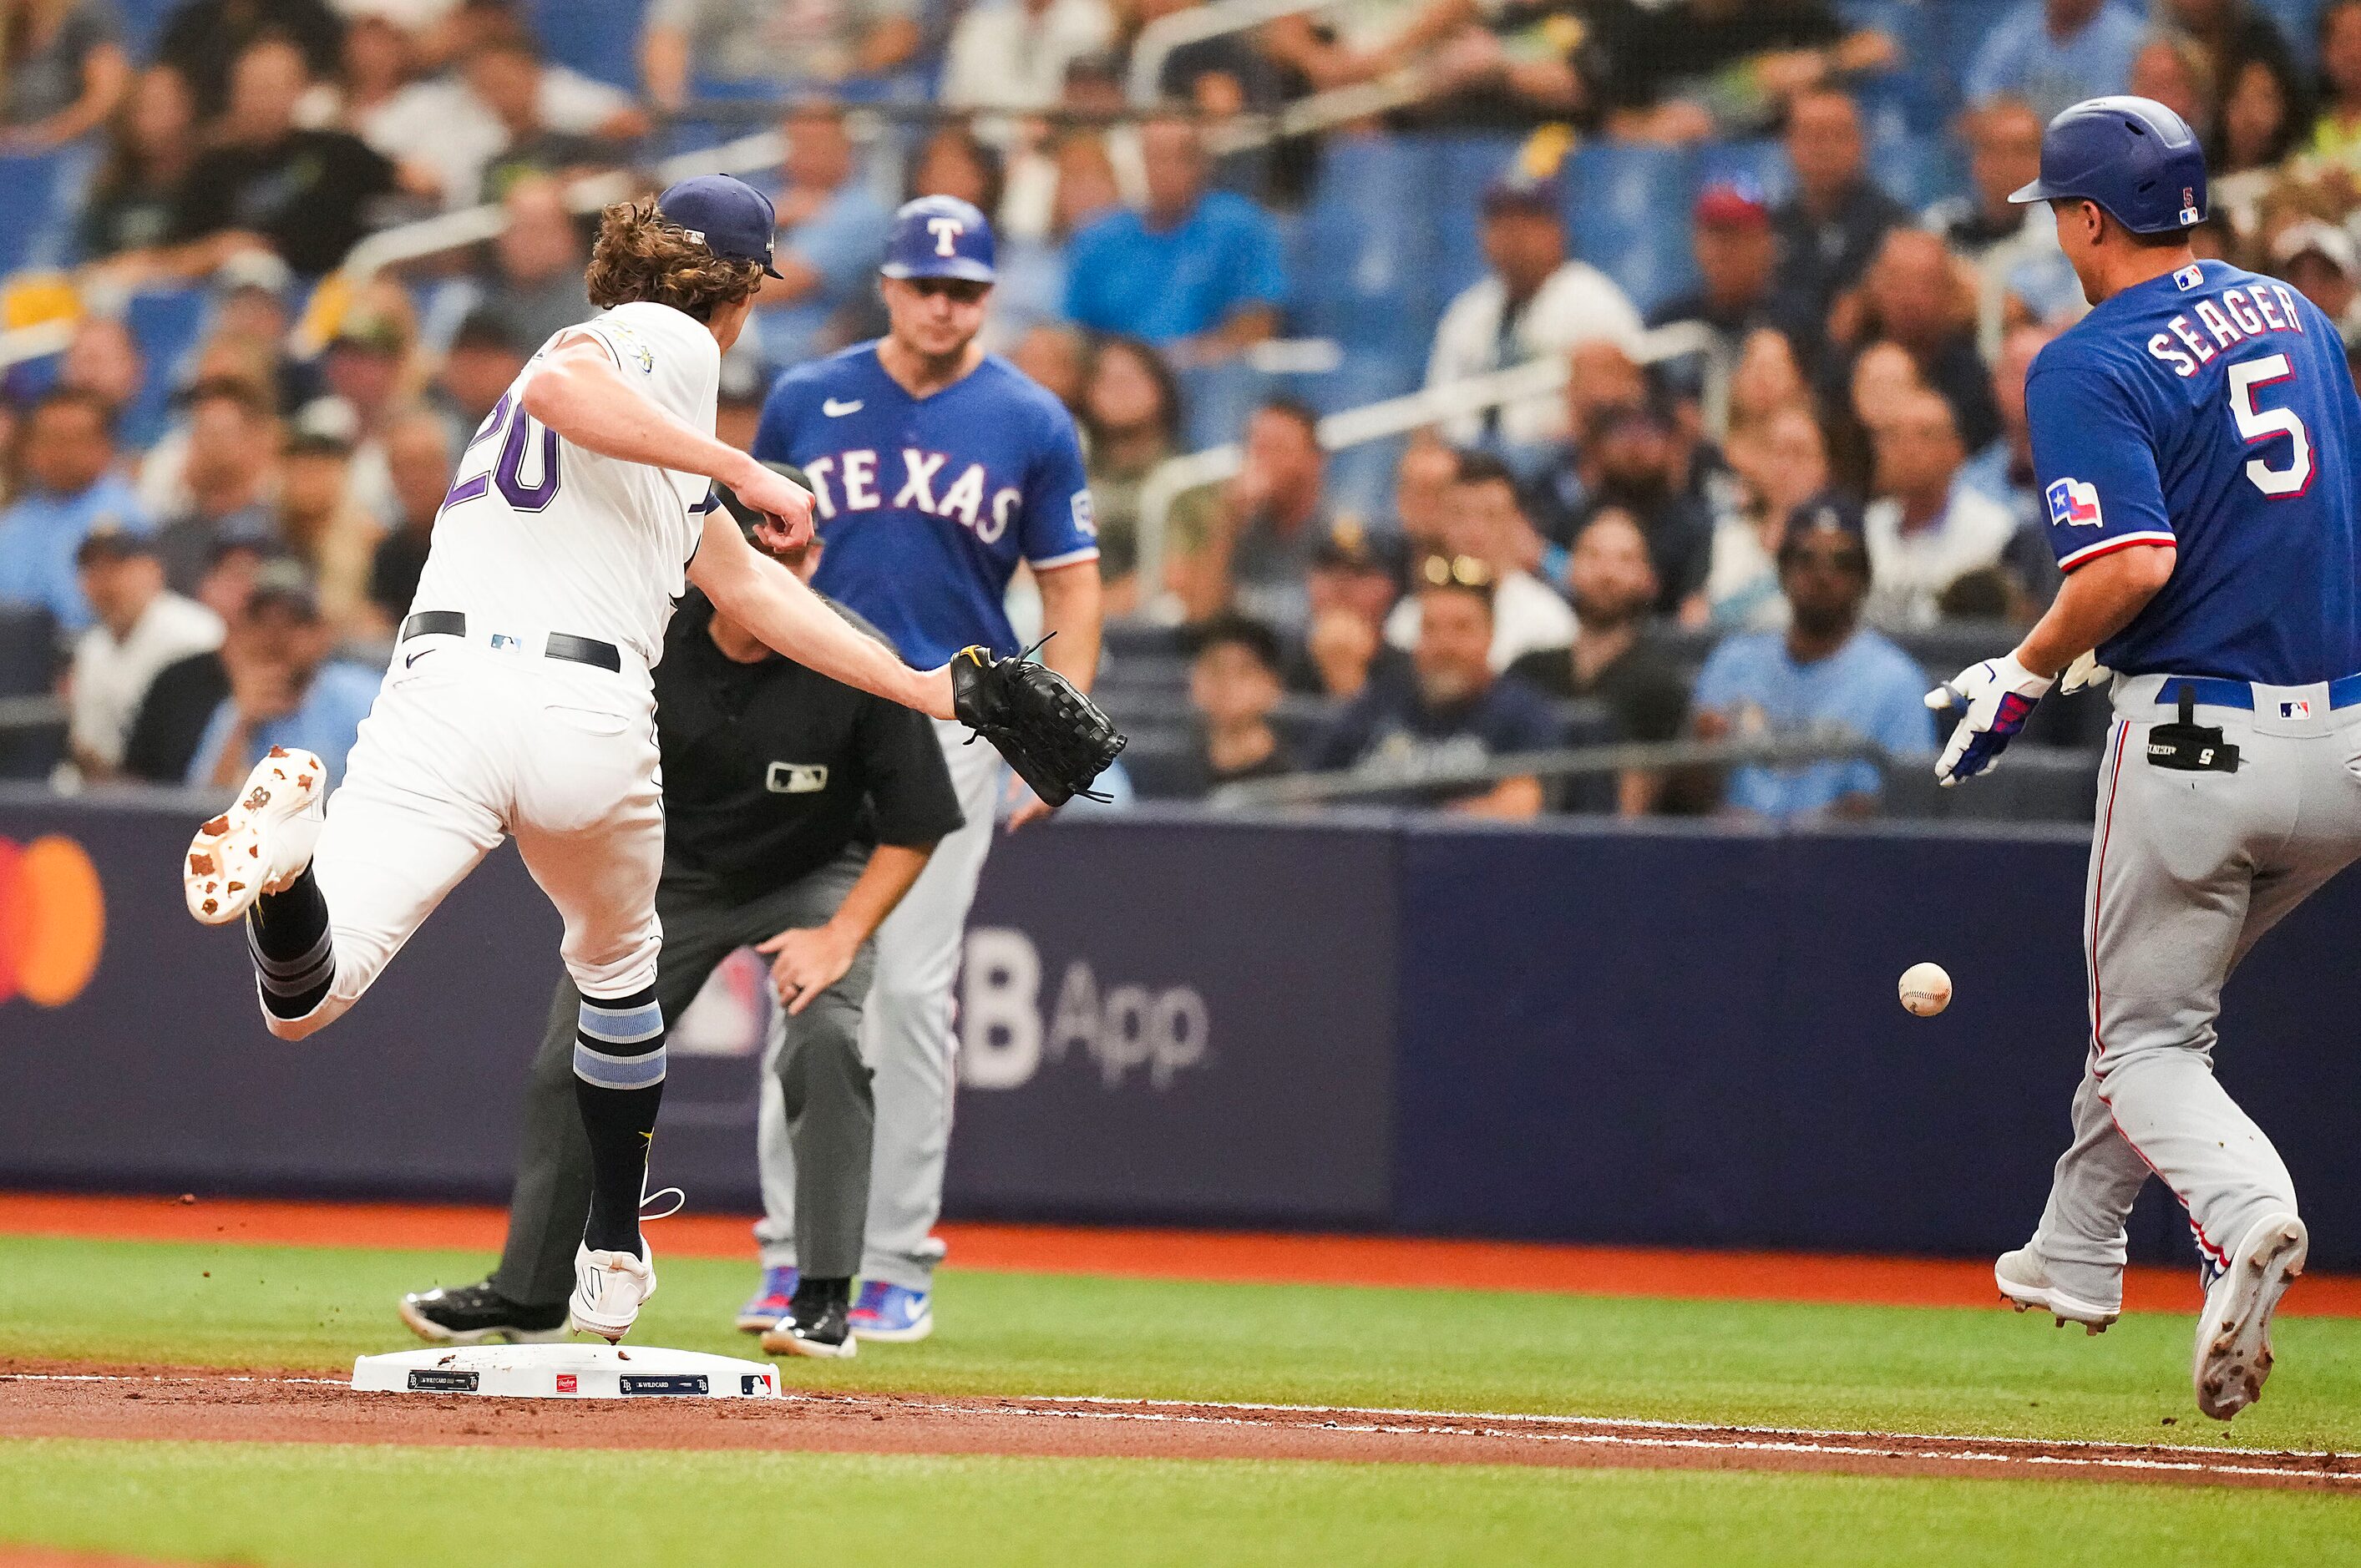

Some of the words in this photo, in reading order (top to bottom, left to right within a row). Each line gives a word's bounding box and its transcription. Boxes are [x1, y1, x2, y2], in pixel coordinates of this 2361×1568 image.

[927, 217, 964, 257] T
[2182, 186, 2193, 209] 5
[2147, 285, 2304, 377] SEAGER
[439, 388, 561, 513] 20
[2227, 352, 2317, 501] 5
[803, 447, 1022, 544] TEXAS
[1047, 960, 1210, 1090] App
[621, 1379, 631, 1391] TB
[697, 1379, 707, 1391] TB
